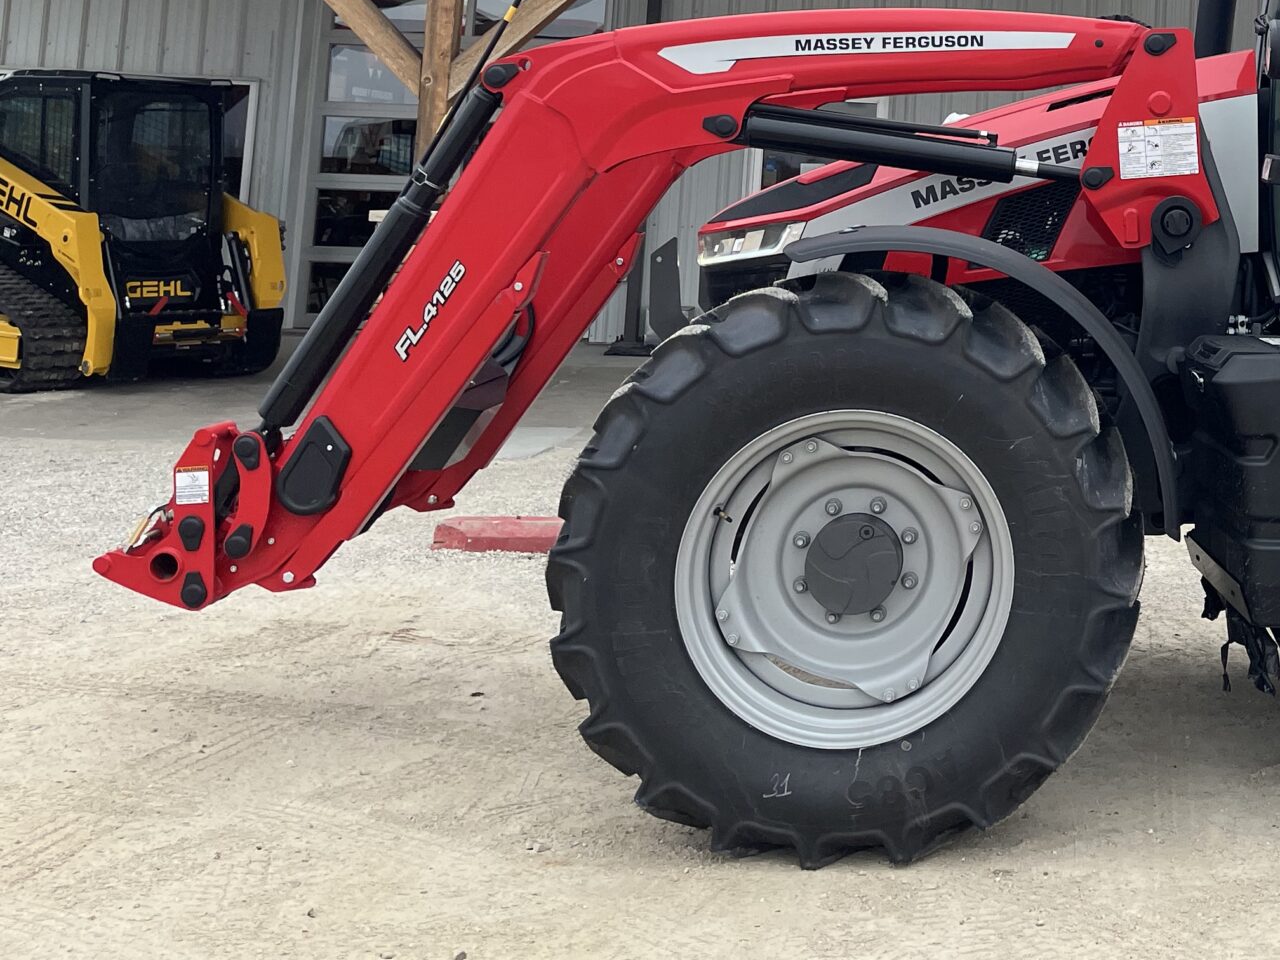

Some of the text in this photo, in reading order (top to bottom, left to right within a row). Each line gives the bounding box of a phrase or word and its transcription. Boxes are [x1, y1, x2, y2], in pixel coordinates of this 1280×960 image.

[795, 35, 984, 52] MASSEY FERGUSON
[126, 280, 192, 298] GEHL
[394, 259, 466, 362] FL.4125
